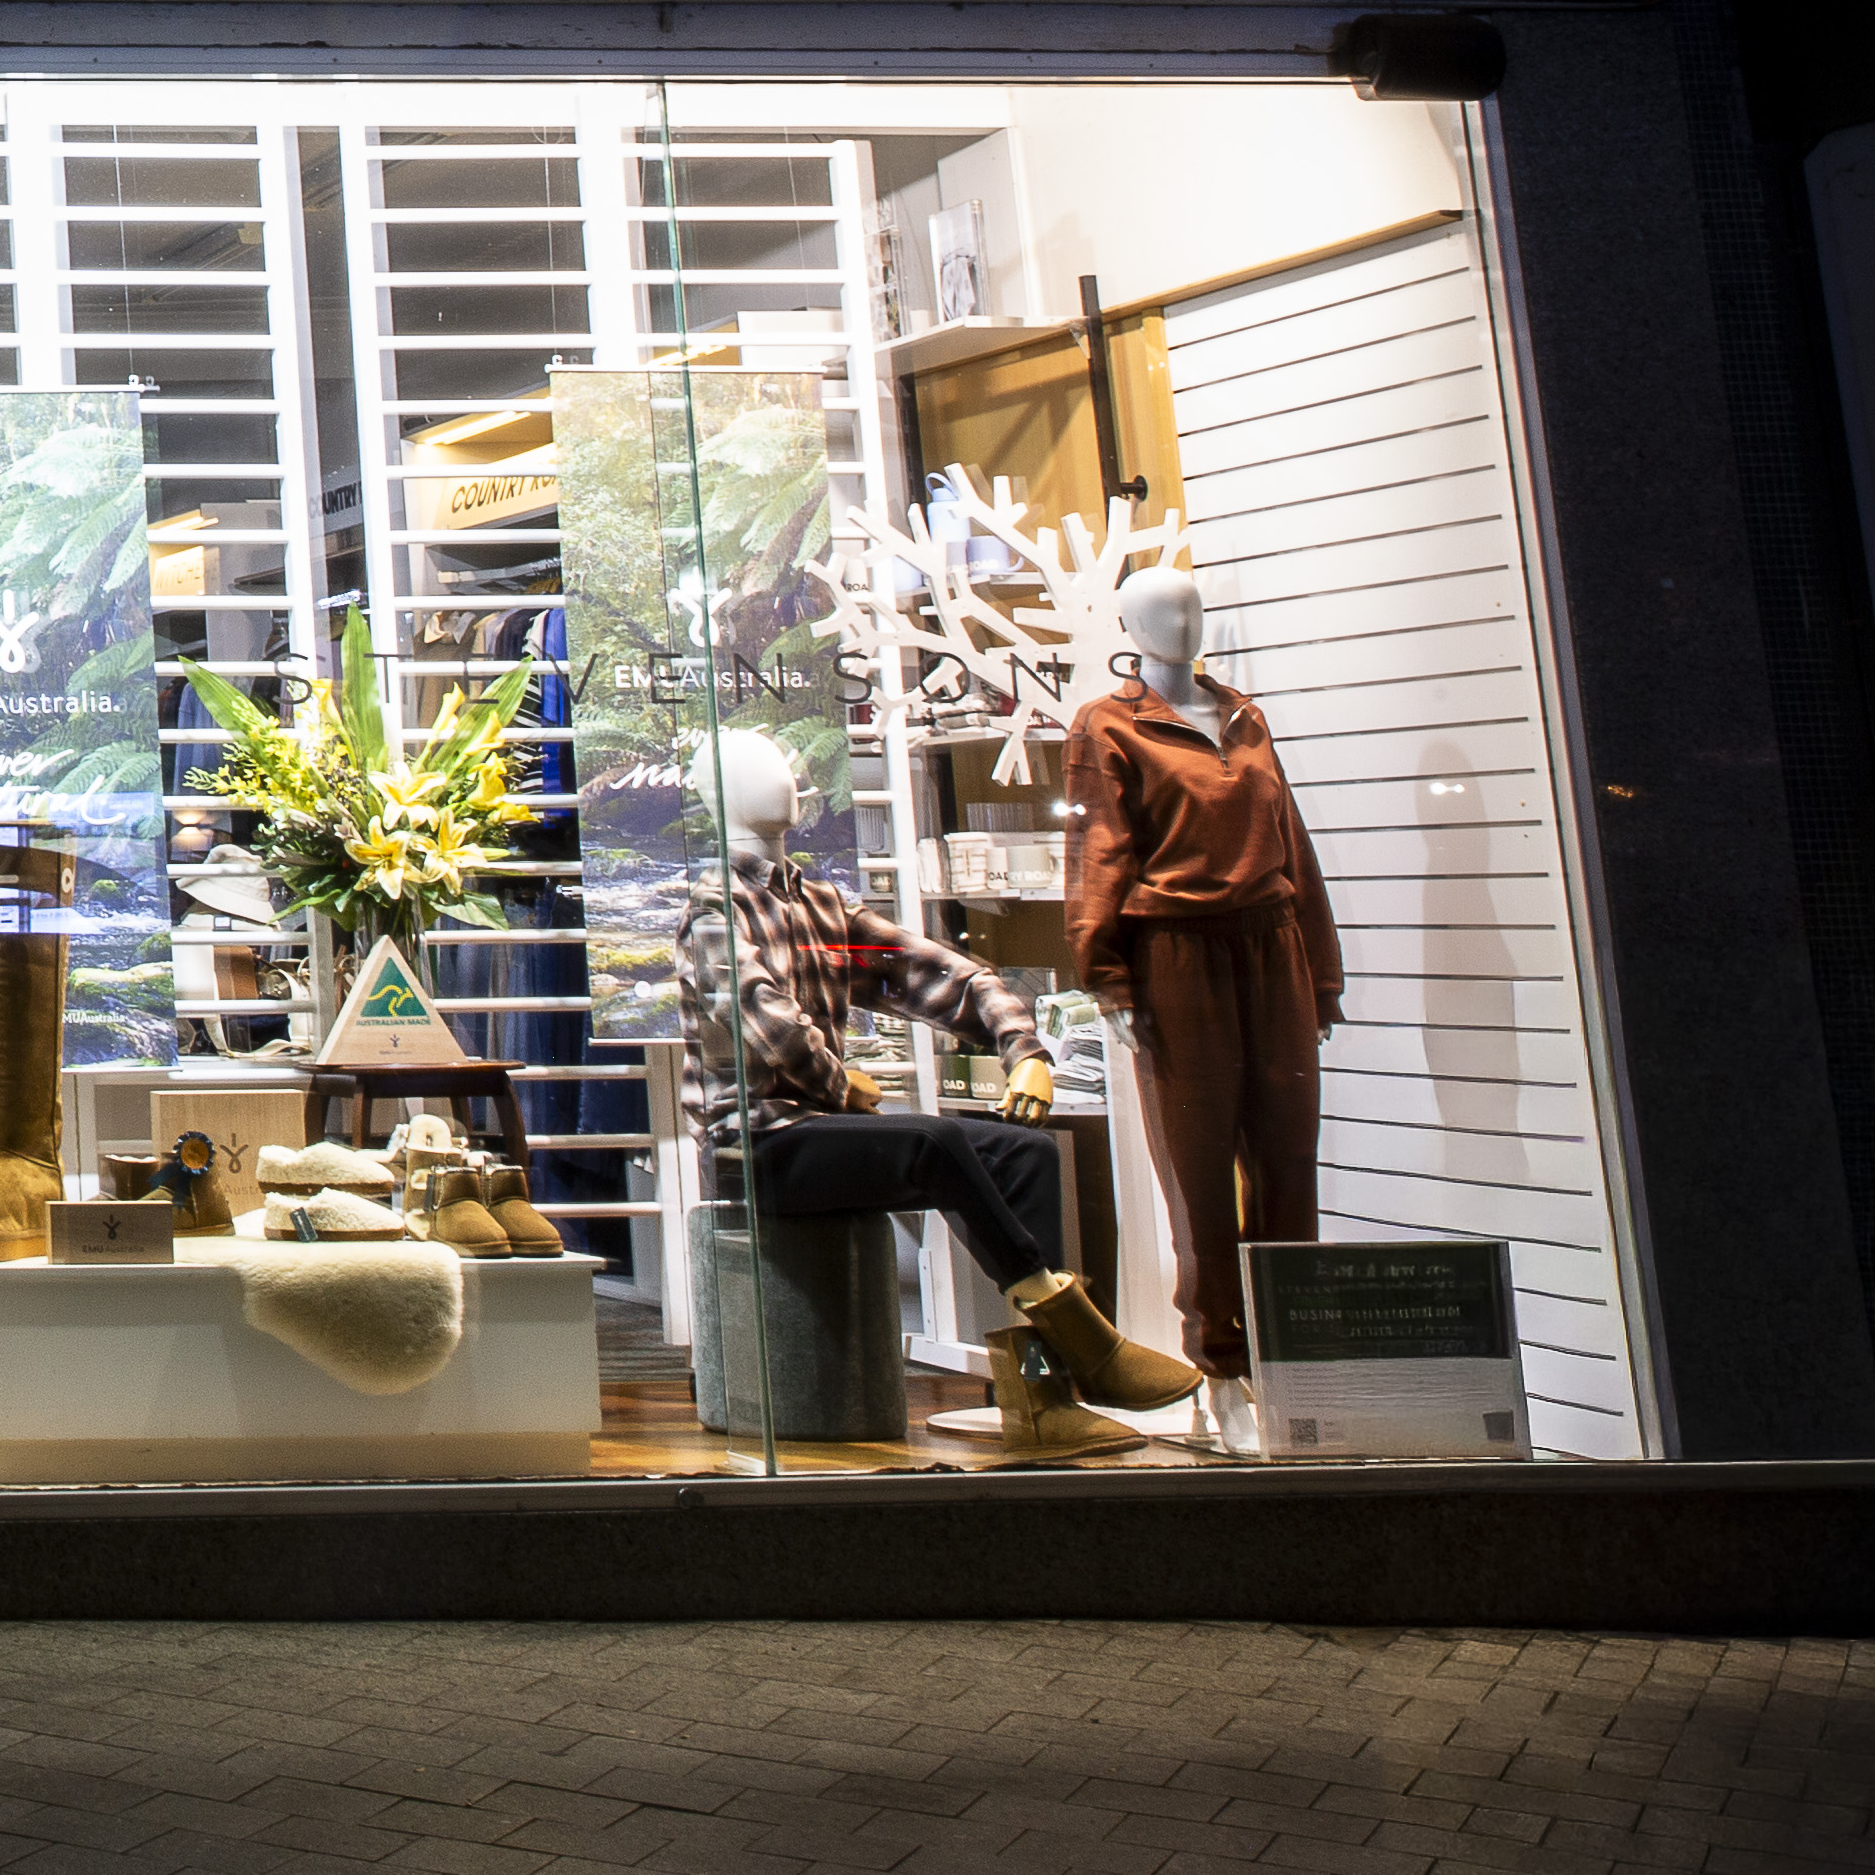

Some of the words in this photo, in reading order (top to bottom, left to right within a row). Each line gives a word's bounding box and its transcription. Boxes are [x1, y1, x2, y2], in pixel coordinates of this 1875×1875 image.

[272, 650, 1149, 707] STEVENSONS
[356, 1018, 405, 1027] AUSTRALIAN
[81, 1244, 104, 1254] EMU
